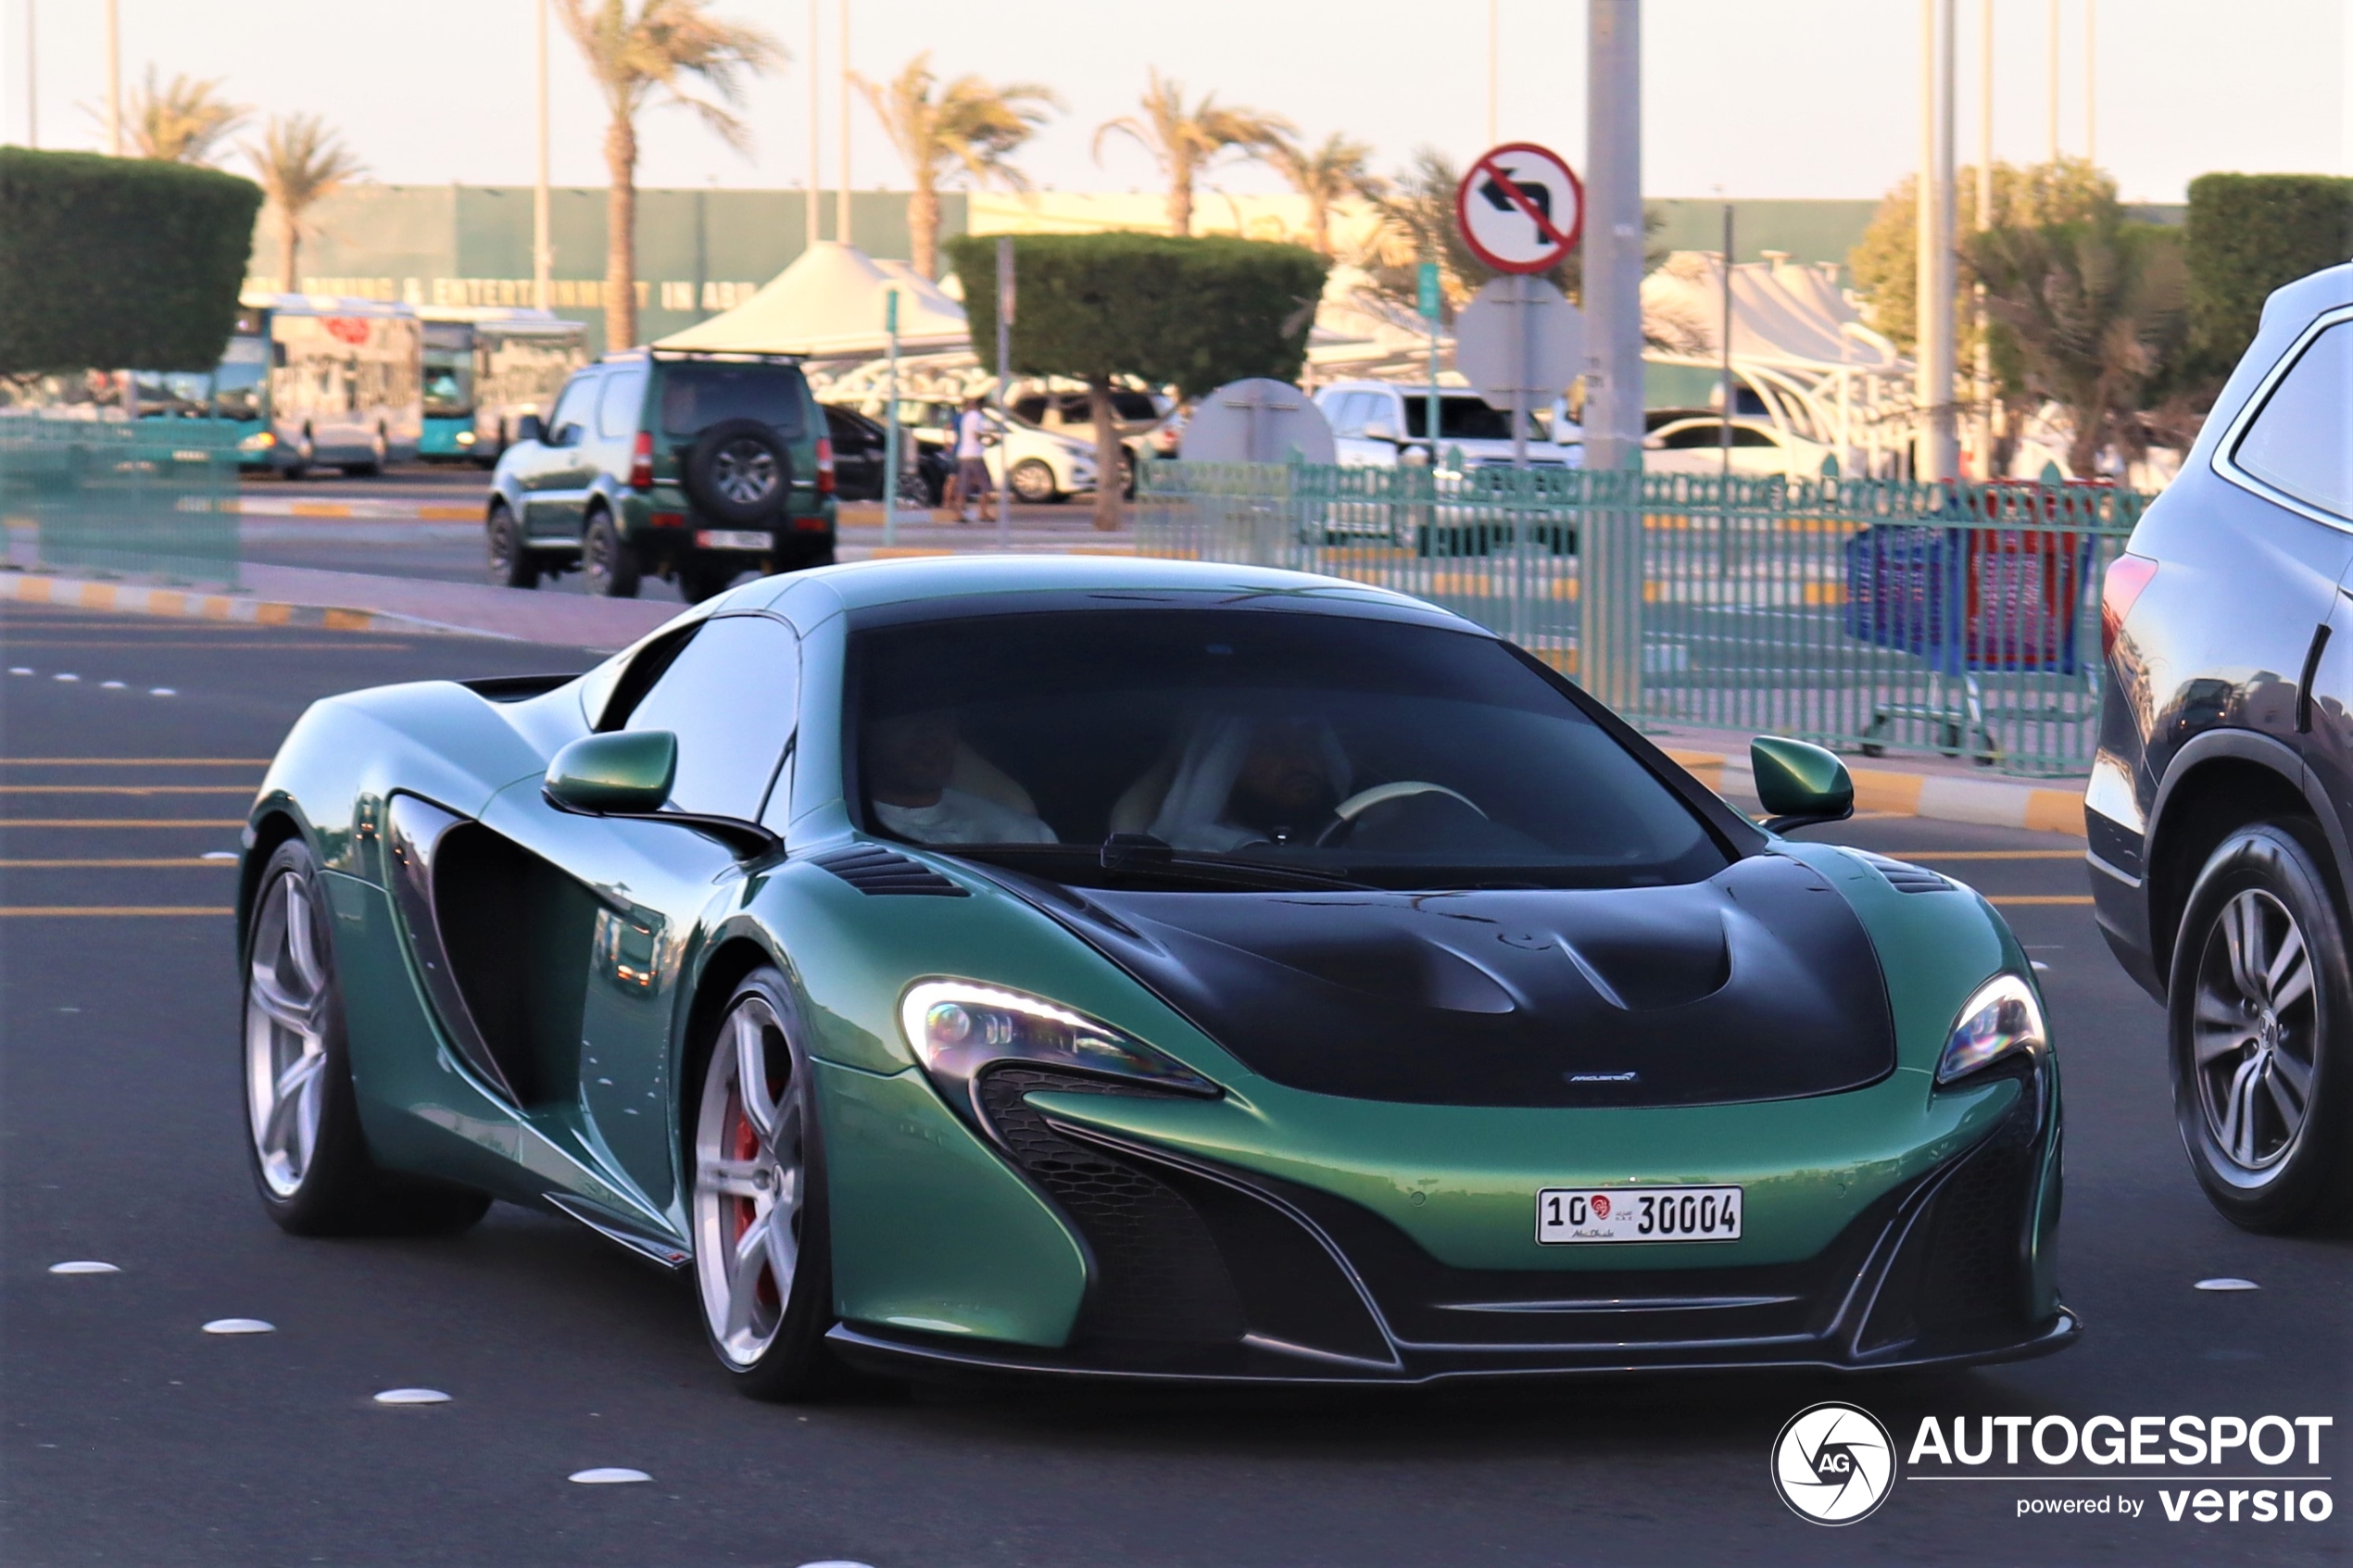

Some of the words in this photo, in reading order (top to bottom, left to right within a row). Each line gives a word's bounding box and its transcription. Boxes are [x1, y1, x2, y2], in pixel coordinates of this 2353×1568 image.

[661, 282, 694, 310] IN
[1547, 1197, 1586, 1226] 10
[1638, 1195, 1735, 1235] 30004
